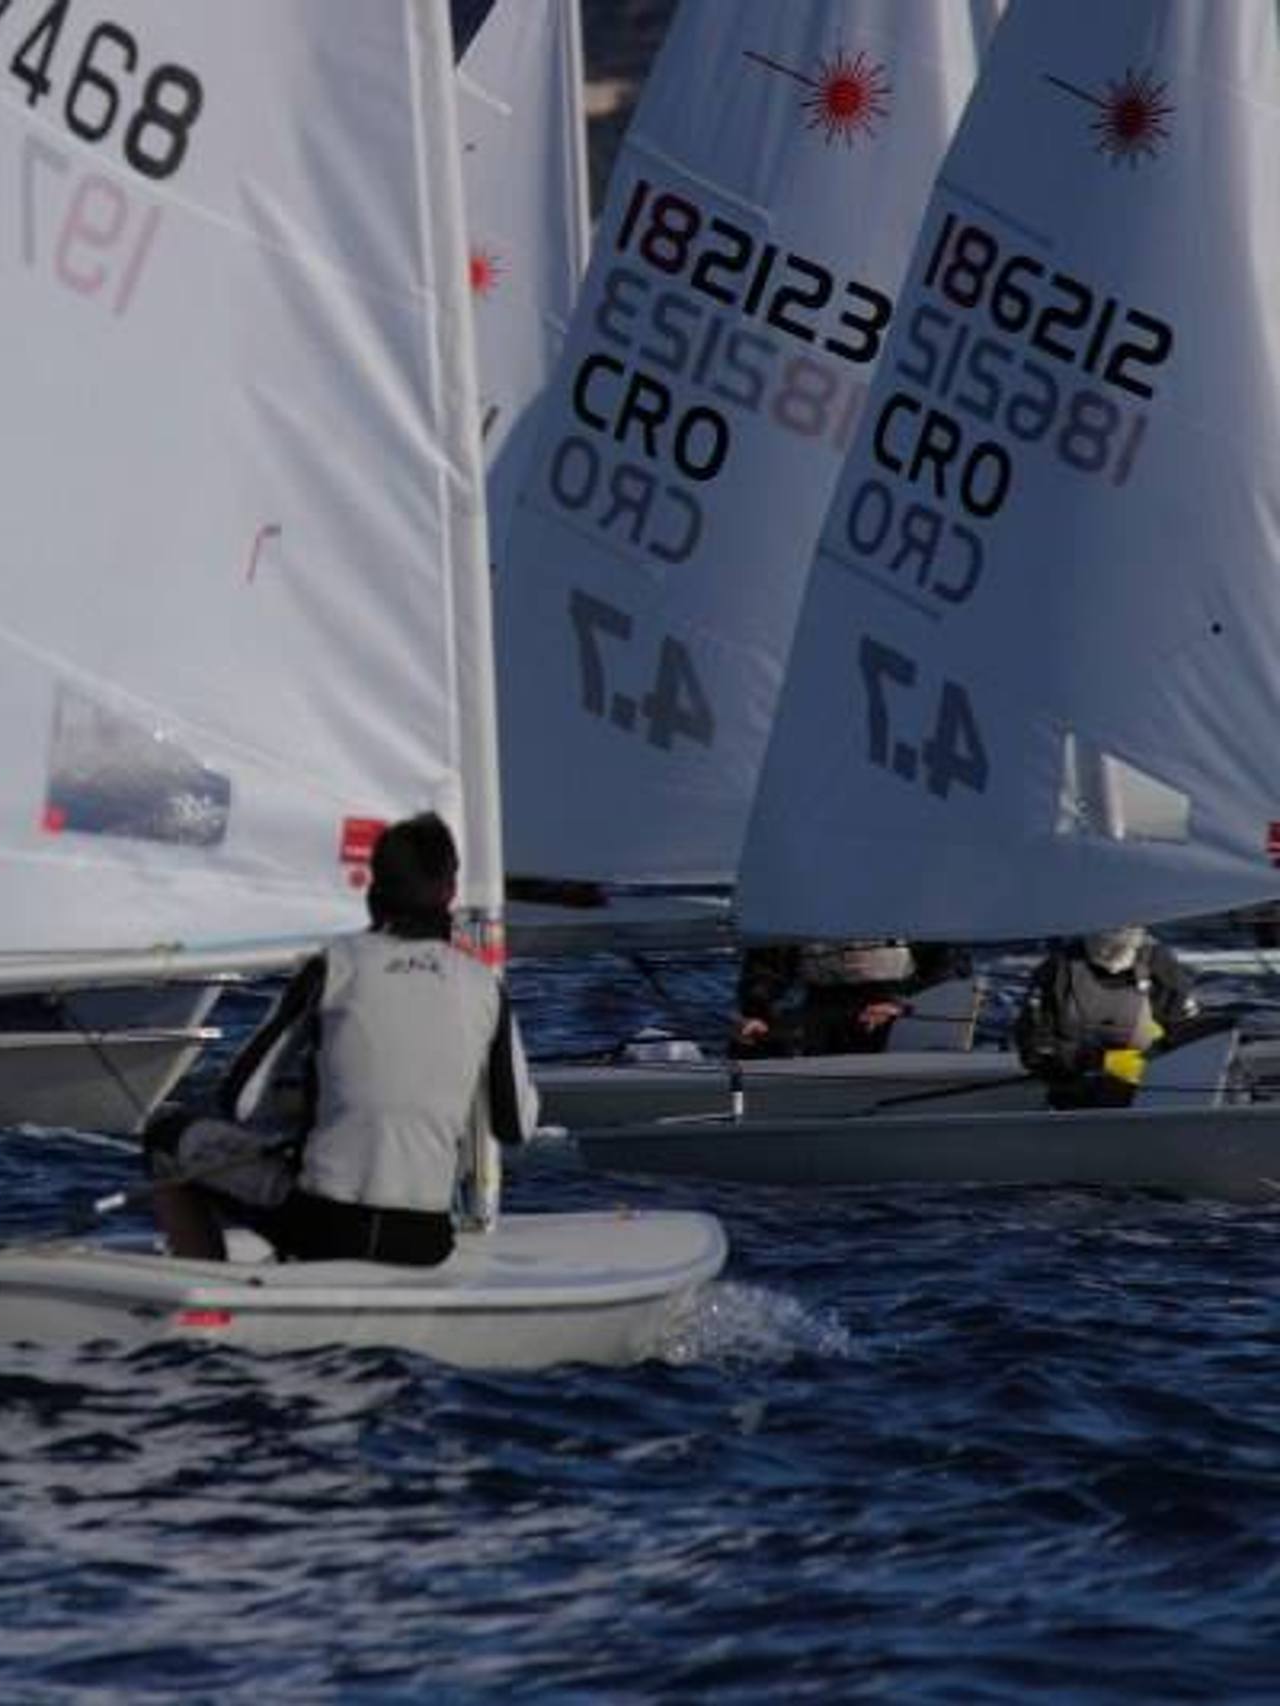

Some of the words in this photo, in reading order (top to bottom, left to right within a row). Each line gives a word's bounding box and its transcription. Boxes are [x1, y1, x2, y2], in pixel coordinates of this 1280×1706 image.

[616, 180, 892, 363] 182123
[924, 213, 1174, 400] 186212
[573, 353, 730, 482] CRO
[873, 392, 1013, 519] CRO
